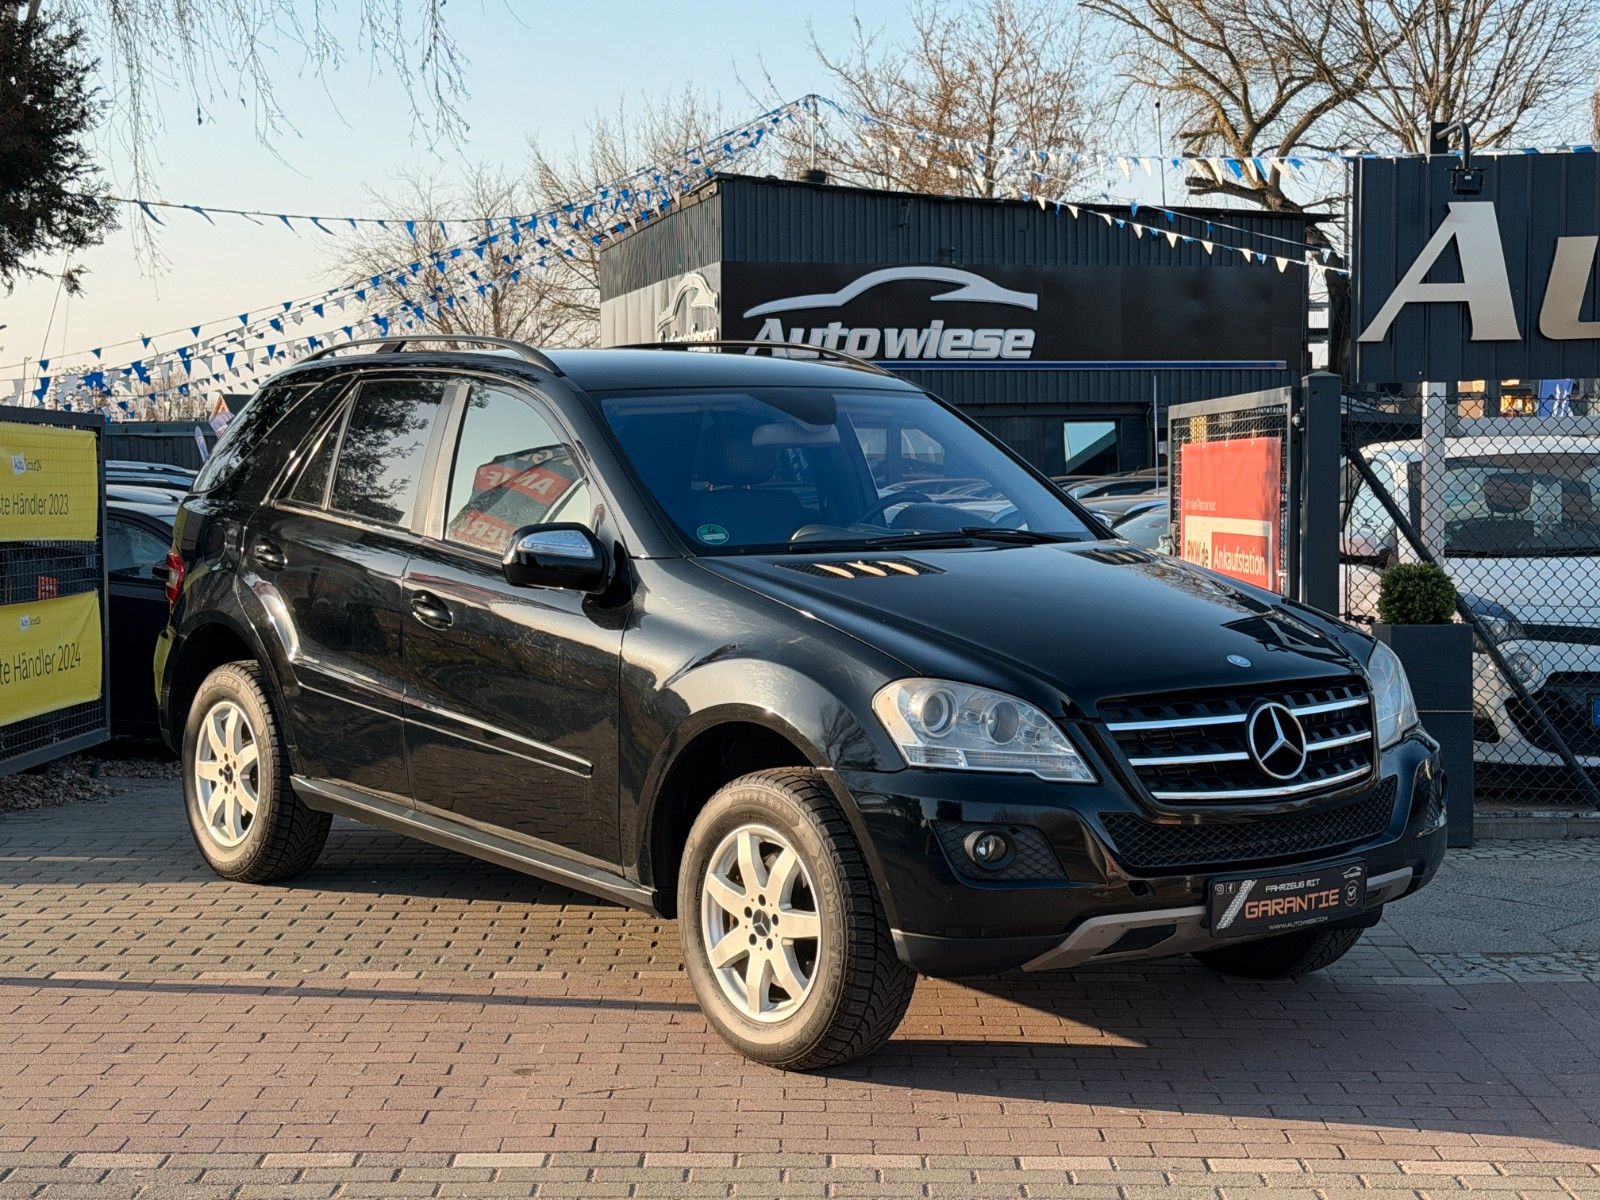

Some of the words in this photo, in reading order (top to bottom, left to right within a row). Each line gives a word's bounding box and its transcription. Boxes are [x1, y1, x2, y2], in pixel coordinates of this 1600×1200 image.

[745, 318, 1036, 359] Autowiese
[12, 492, 47, 516] Händler
[49, 493, 69, 516] 2023
[1213, 544, 1266, 577] Ankaufstation
[13, 648, 55, 681] Händler
[58, 642, 81, 671] 2024
[1265, 881, 1305, 893] FAHRZEUG
[1306, 878, 1320, 888] MIT
[1244, 888, 1340, 919] GARANTIE
